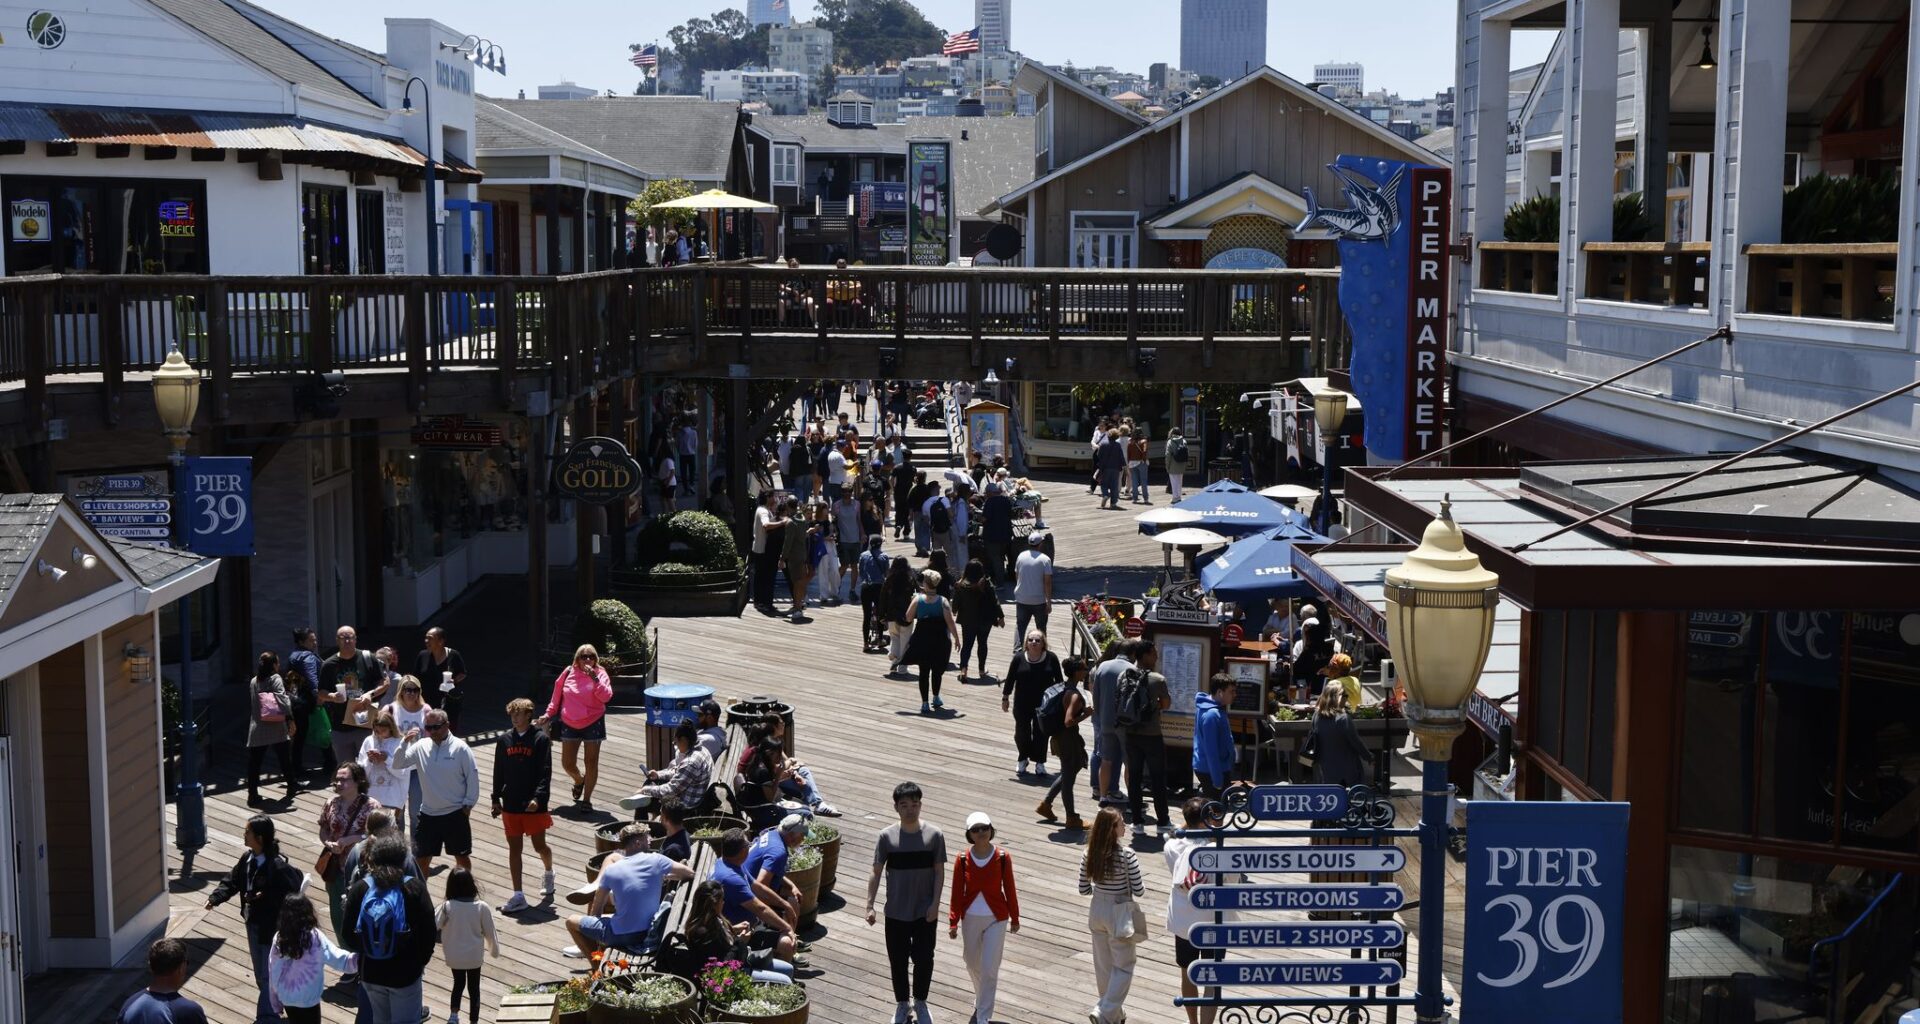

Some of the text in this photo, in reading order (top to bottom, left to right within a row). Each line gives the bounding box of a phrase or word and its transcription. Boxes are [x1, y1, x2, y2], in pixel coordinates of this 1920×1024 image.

[436, 60, 449, 90] TACO
[13, 204, 46, 217] Modelo
[1416, 180, 1442, 450] PIER MARKET
[423, 432, 483, 441] CITY WEAR
[568, 458, 626, 471] San Francisco
[109, 480, 140, 488] PIER 39
[194, 474, 243, 492] PIER
[563, 469, 631, 488] GOLD
[194, 494, 247, 534] 39
[1160, 610, 1206, 620] PIER MARKET
[1357, 601, 1373, 628] CHIPS
[506, 746, 532, 756] GIANTS
[1262, 794, 1338, 812] PIER 39
[1231, 853, 1356, 869] SWISS LOUIS
[1485, 847, 1602, 887] PIER
[1238, 890, 1359, 907] RESTROOMS
[1227, 929, 1374, 945] LEVEL 2 SHOPS
[1476, 894, 1605, 988] 39
[1239, 966, 1343, 982] BAY VIEWS
